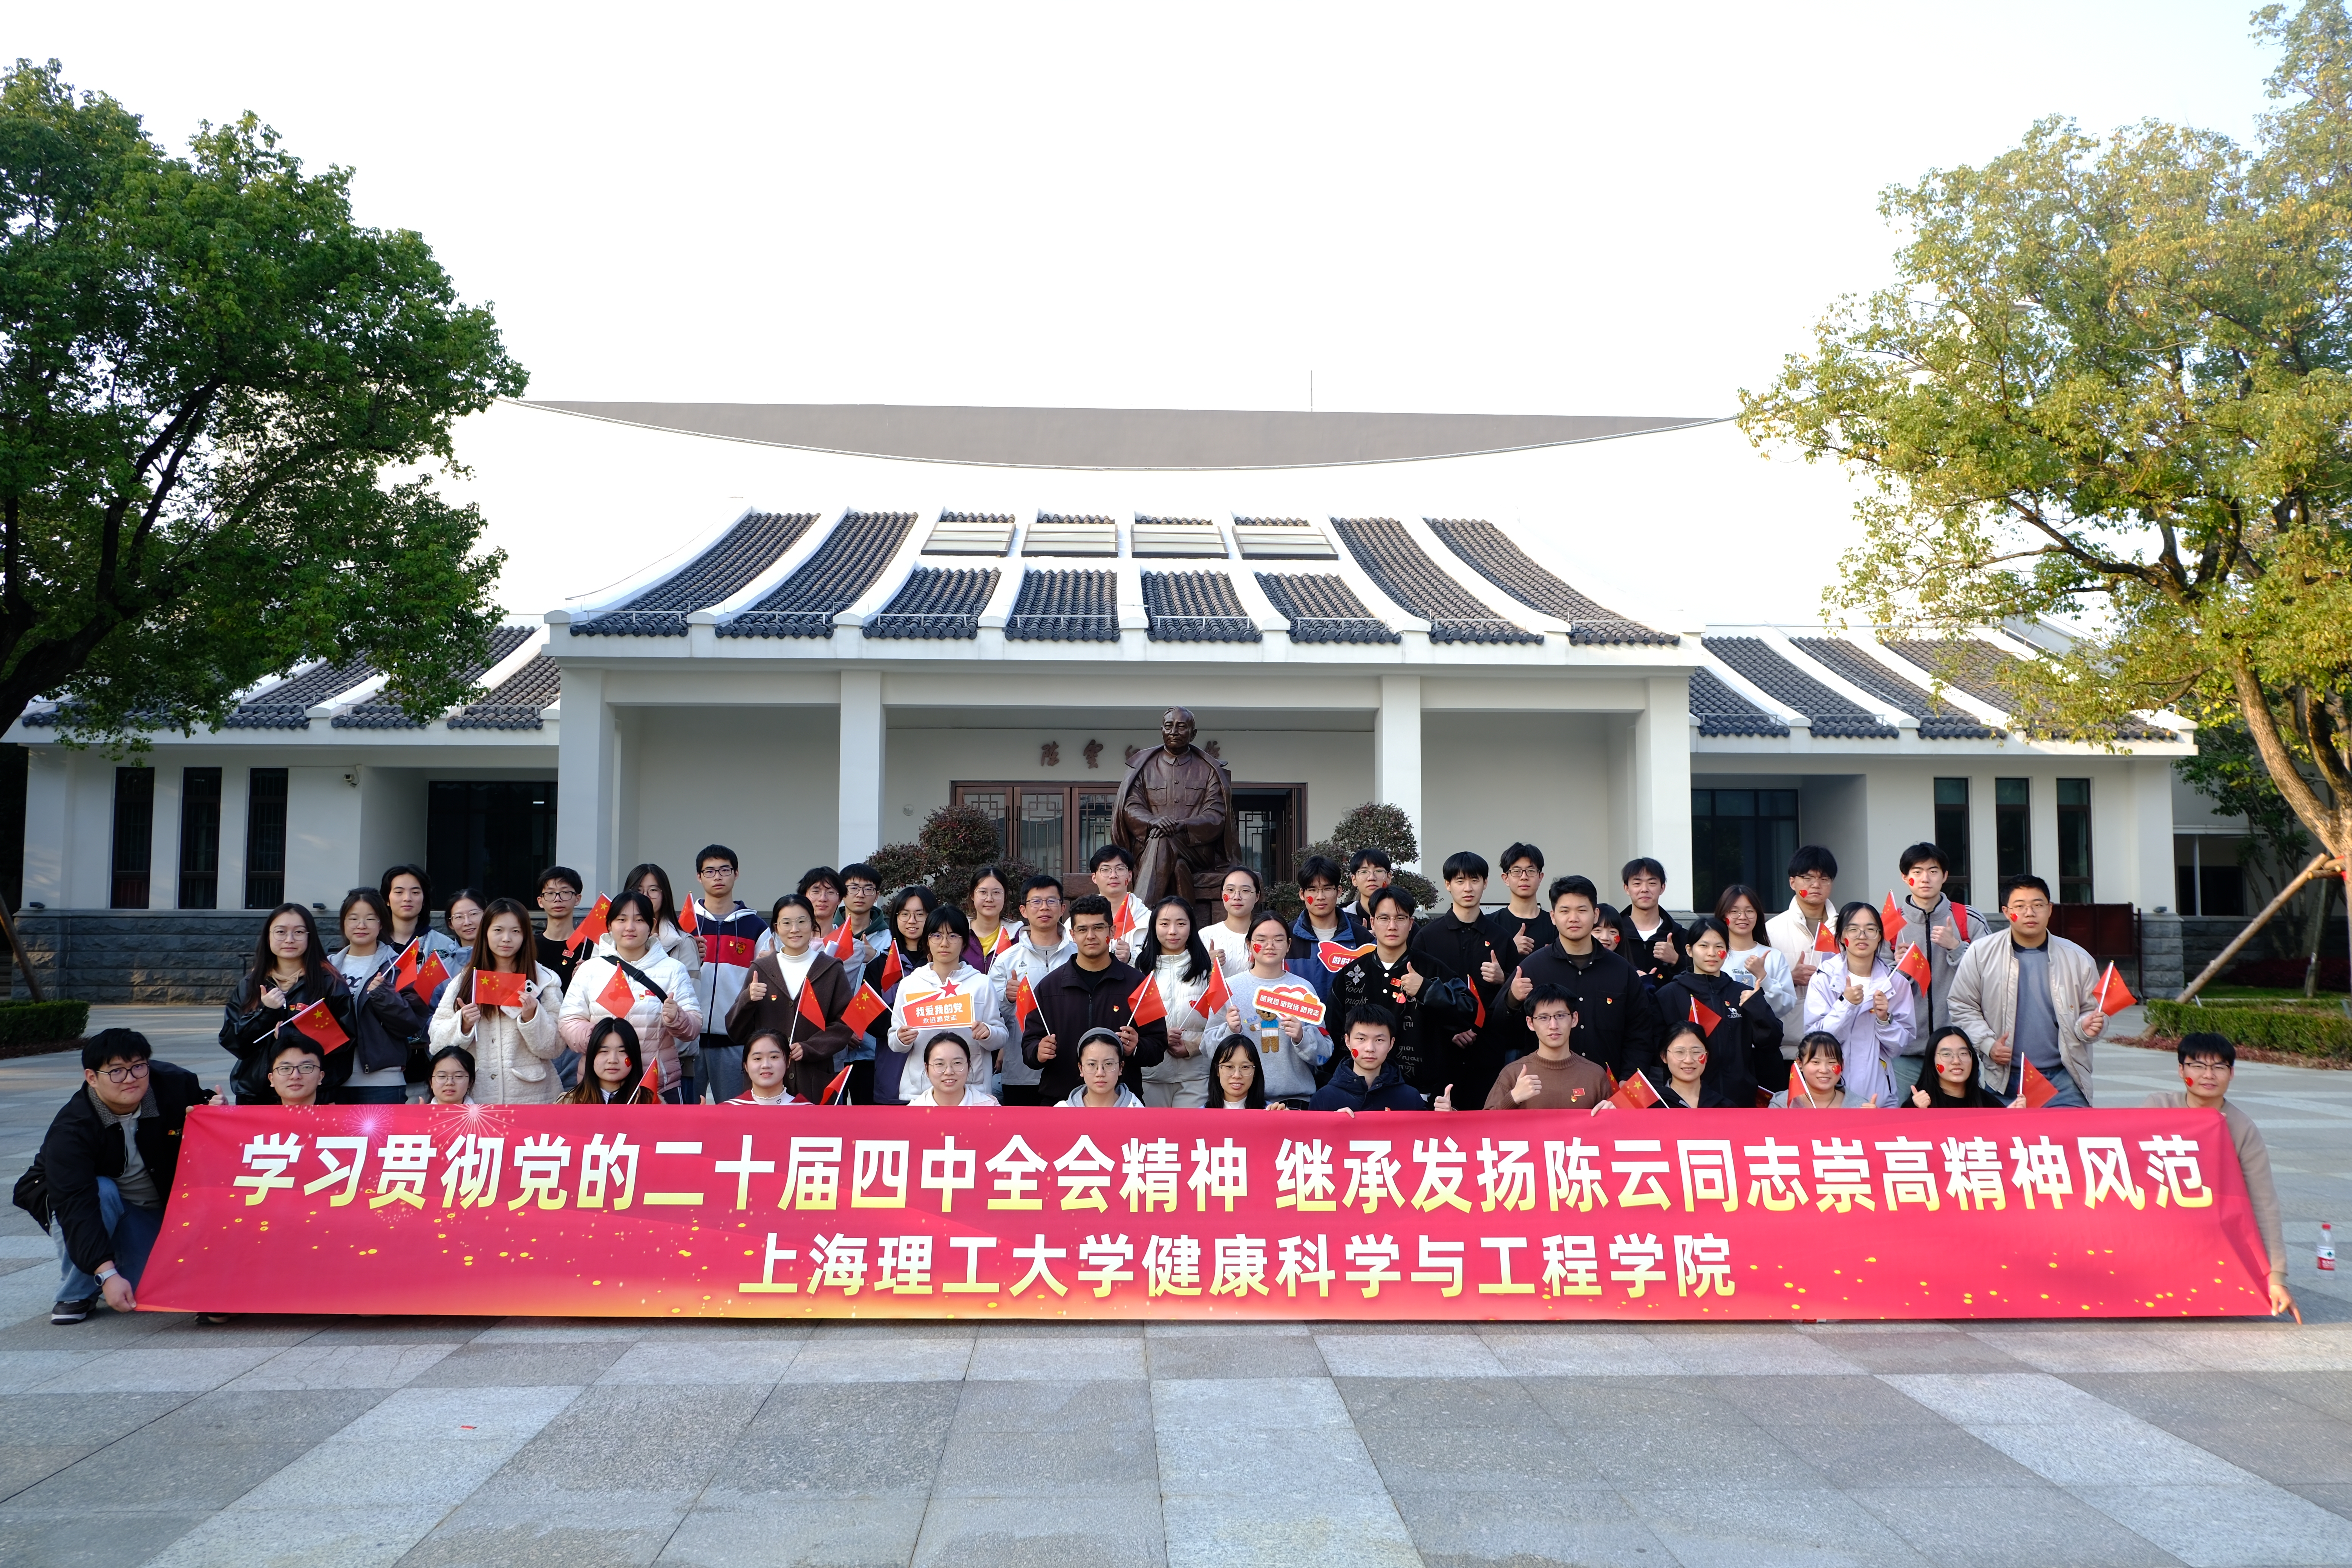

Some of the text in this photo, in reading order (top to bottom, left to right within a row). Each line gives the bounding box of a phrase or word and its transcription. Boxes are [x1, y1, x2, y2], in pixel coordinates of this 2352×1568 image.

[916, 1003, 963, 1017] 我爱我的党
[1260, 995, 1320, 1017] 感党恩 听党话 跟党走
[923, 1015, 957, 1024] 永远跟党走
[233, 1133, 2213, 1214] 学习贯彻党的二十届四中全会精神 继承发扬陈云同志崇高精神风范
[738, 1233, 1735, 1298] 上海理工大学健康科学与工程学院
